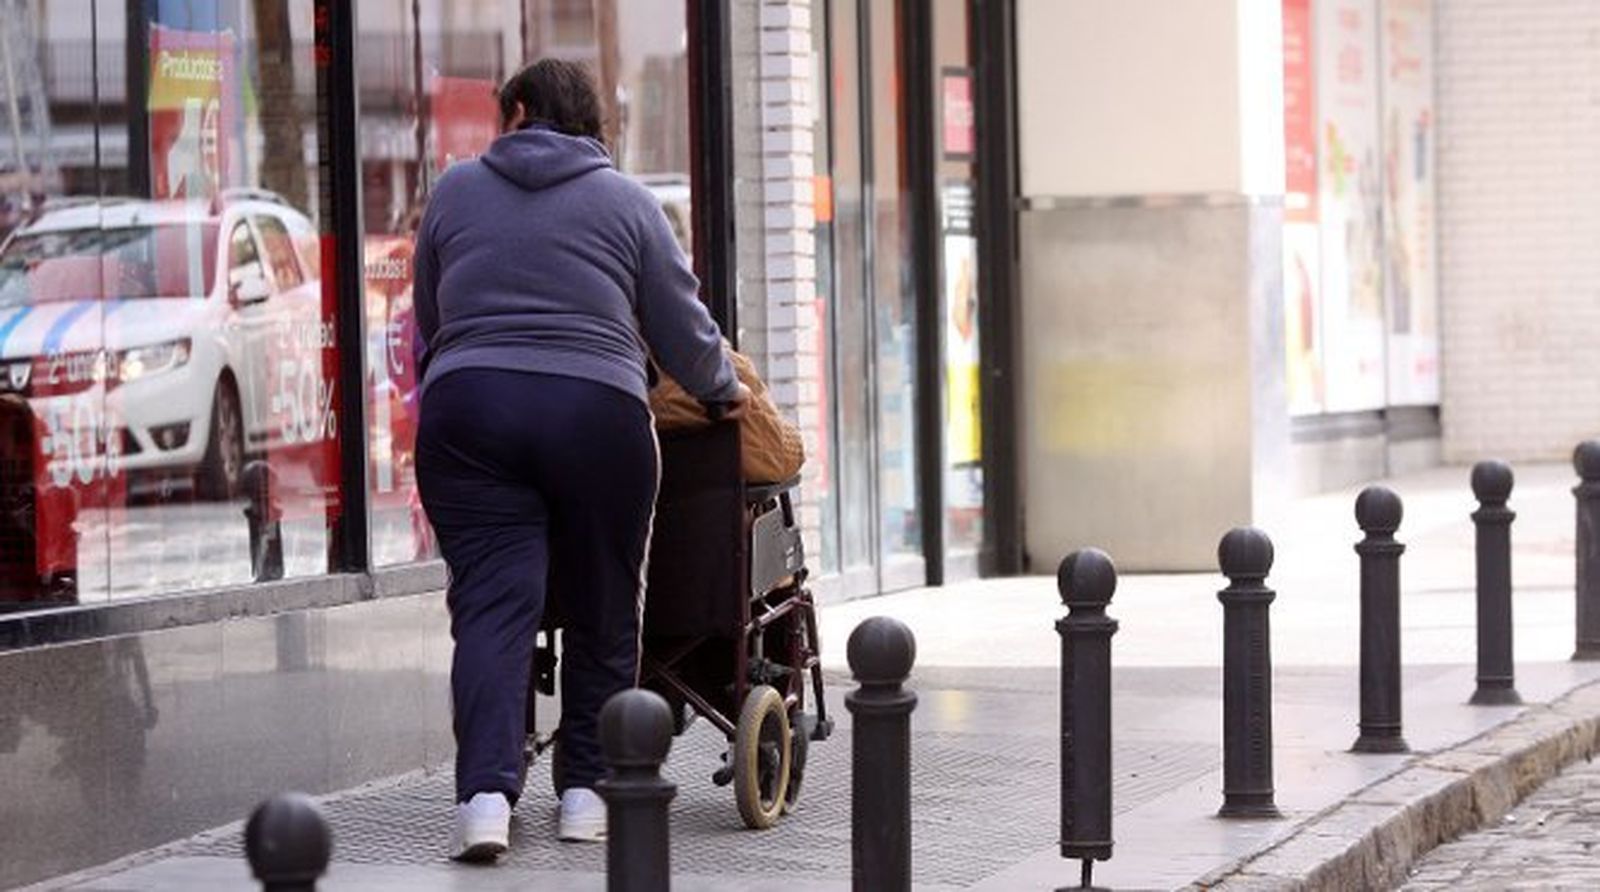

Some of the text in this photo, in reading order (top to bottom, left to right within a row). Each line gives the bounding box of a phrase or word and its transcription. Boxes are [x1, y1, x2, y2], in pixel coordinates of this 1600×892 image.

[160, 50, 216, 81] Productos
[41, 396, 120, 488] -50%
[272, 358, 337, 444] -50%
